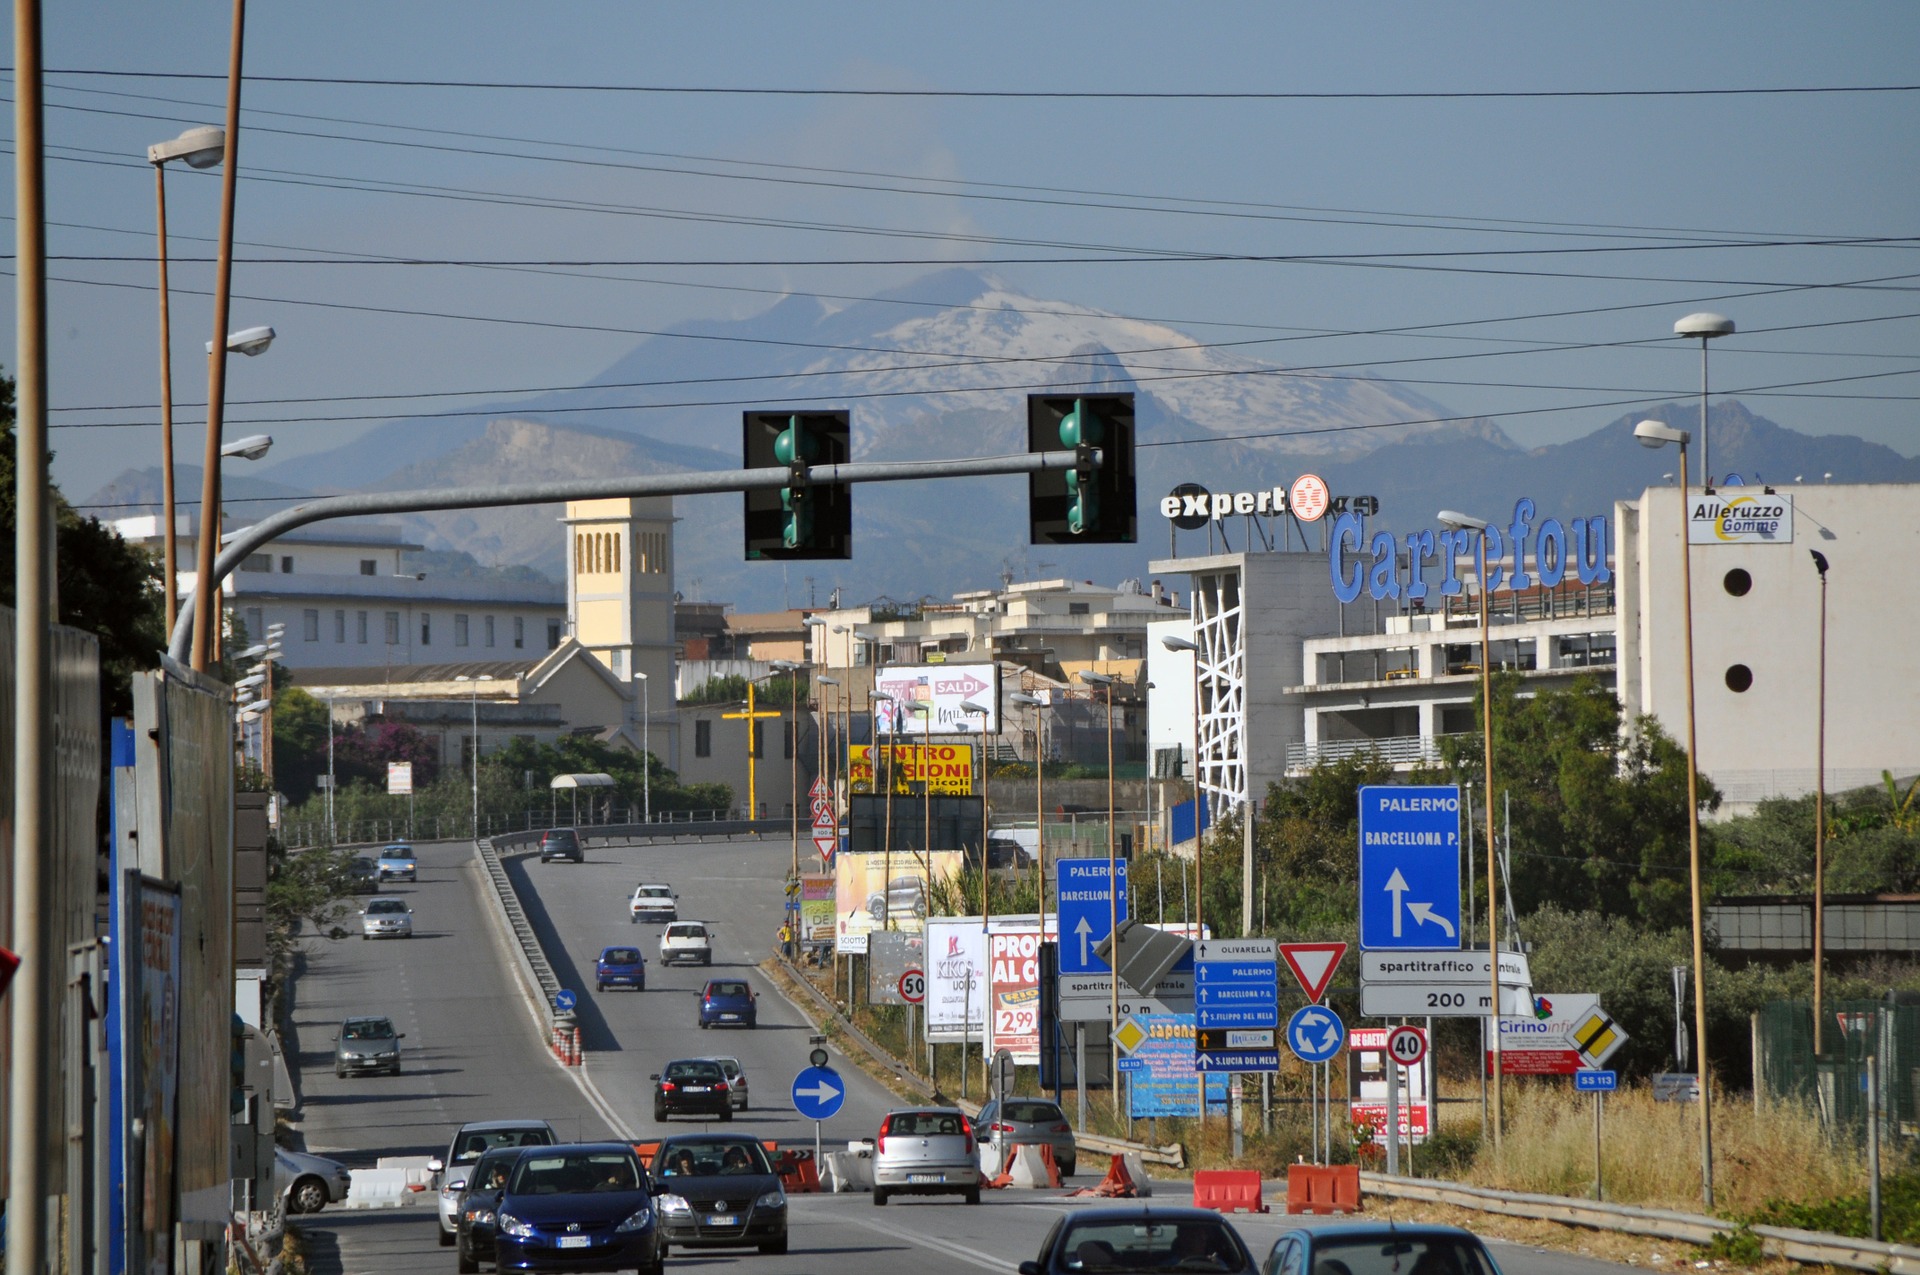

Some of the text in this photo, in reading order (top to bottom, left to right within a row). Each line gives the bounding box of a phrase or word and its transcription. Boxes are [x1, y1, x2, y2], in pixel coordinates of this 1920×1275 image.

[1160, 487, 1285, 520] expert
[1693, 503, 1783, 519] Alleruzzo
[1722, 519, 1778, 532] Gomme
[937, 681, 978, 693] SALDI
[862, 746, 956, 761] CNTRO
[850, 763, 970, 778] RESIONI
[1380, 798, 1458, 812] PALERMO
[1365, 832, 1441, 845] BARCELLONA
[1221, 946, 1272, 954] OLIVARELLA
[936, 959, 974, 979] KIKOS
[993, 960, 1020, 983] AL
[1379, 960, 1521, 974] spartitraffico cntrale
[905, 978, 924, 994] 50
[953, 980, 976, 990] UOO
[1072, 980, 1185, 991] spartitrafic ntrale
[1427, 993, 1493, 1007] 200 m
[1107, 1004, 1151, 1014] 10 m
[1210, 1012, 1240, 1020] S.FILIPPO
[1243, 1012, 1255, 1020] DEL
[1001, 1011, 1033, 1034] 2,99
[1350, 1033, 1361, 1047] DE
[1395, 1036, 1418, 1055] 40
[1215, 1056, 1277, 1065] S.LUCIA DEL MELA
[1581, 1077, 1612, 1085] SS 113
